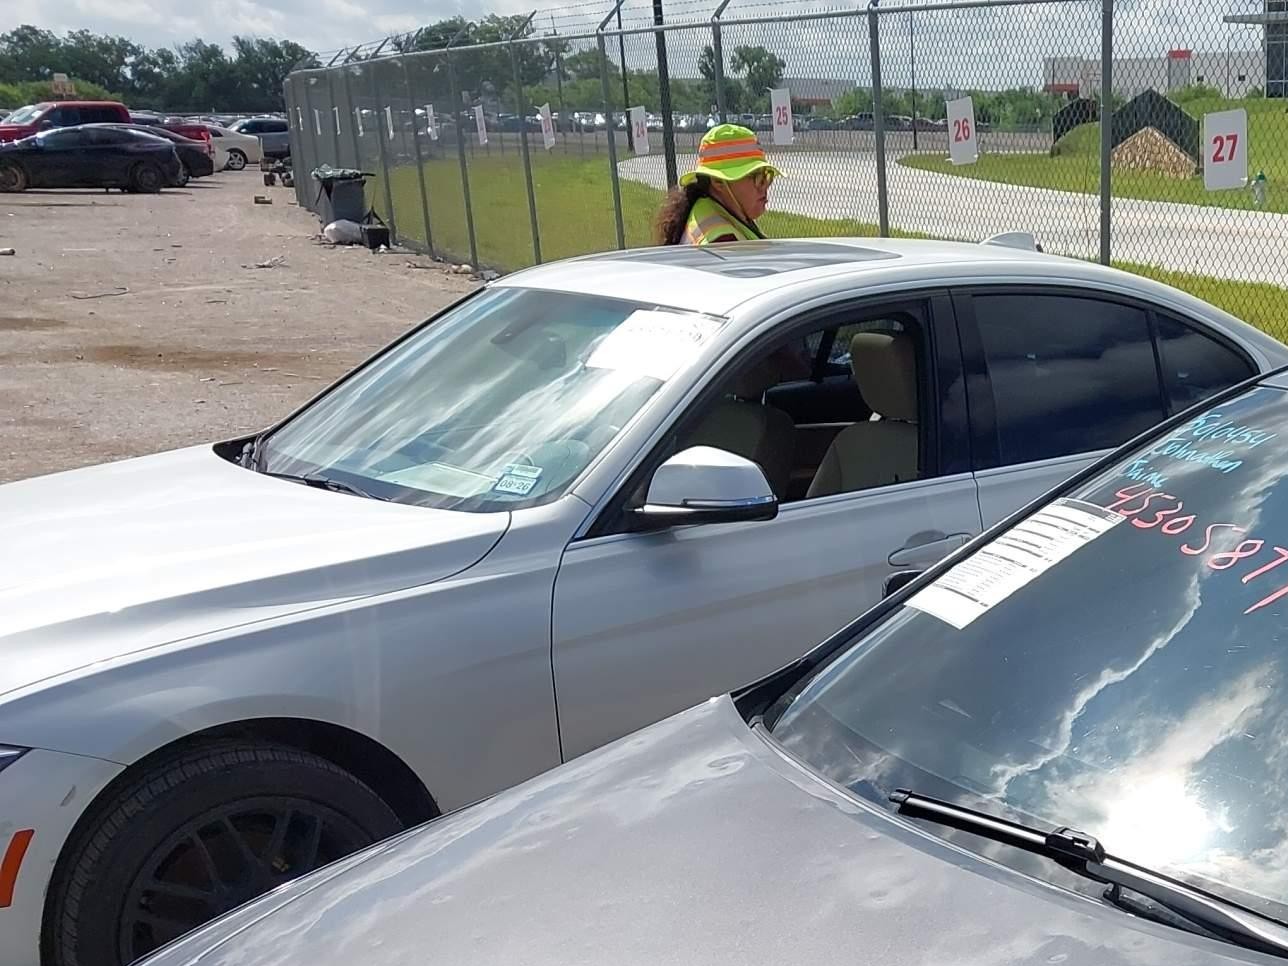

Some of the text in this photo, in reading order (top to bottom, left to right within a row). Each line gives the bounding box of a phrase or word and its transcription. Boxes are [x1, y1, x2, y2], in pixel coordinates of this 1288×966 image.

[775, 106, 789, 126] 25
[635, 121, 646, 138] 24
[953, 117, 971, 142] 26
[1212, 133, 1239, 163] 27
